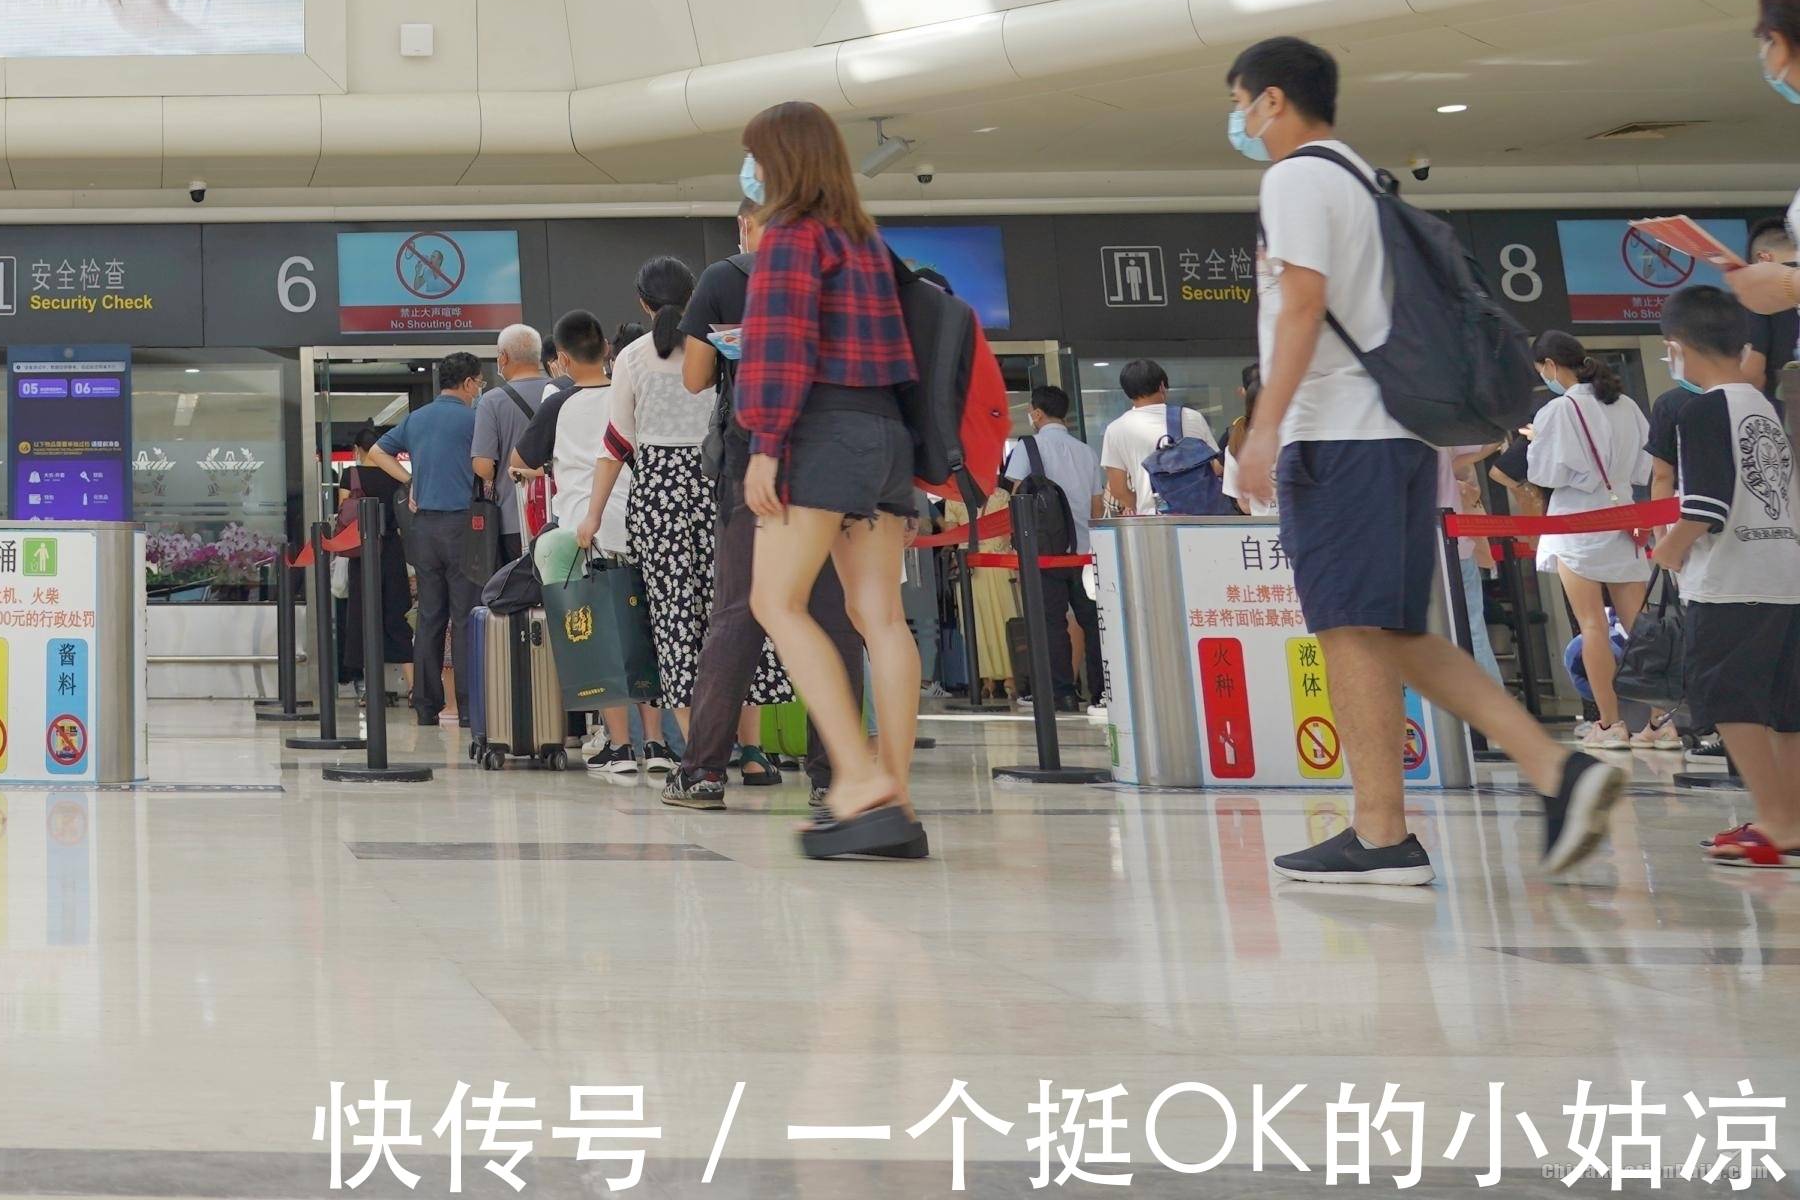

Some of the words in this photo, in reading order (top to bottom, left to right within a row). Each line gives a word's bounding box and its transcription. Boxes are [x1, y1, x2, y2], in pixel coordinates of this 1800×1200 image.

[31, 258, 125, 291] 安全检查
[1179, 248, 1253, 281] 安全检
[1500, 243, 1543, 303] 8
[277, 255, 317, 313] 6
[1182, 285, 1251, 304] Security
[30, 294, 97, 313] Security
[102, 294, 153, 310] Check
[1623, 310, 1638, 319] No
[390, 320, 405, 329] No
[407, 319, 452, 330] Shouting
[454, 319, 473, 328] Out
[22, 382, 38, 395] 05
[74, 382, 91, 395] 06
[1241, 534, 1290, 571] 自弃
[1226, 584, 1301, 604] 禁止携带打
[1189, 608, 1304, 628] 违者将面临最高5
[58, 643, 77, 697] 酱料
[1213, 642, 1234, 699] 火种
[1299, 642, 1322, 697] 液体
